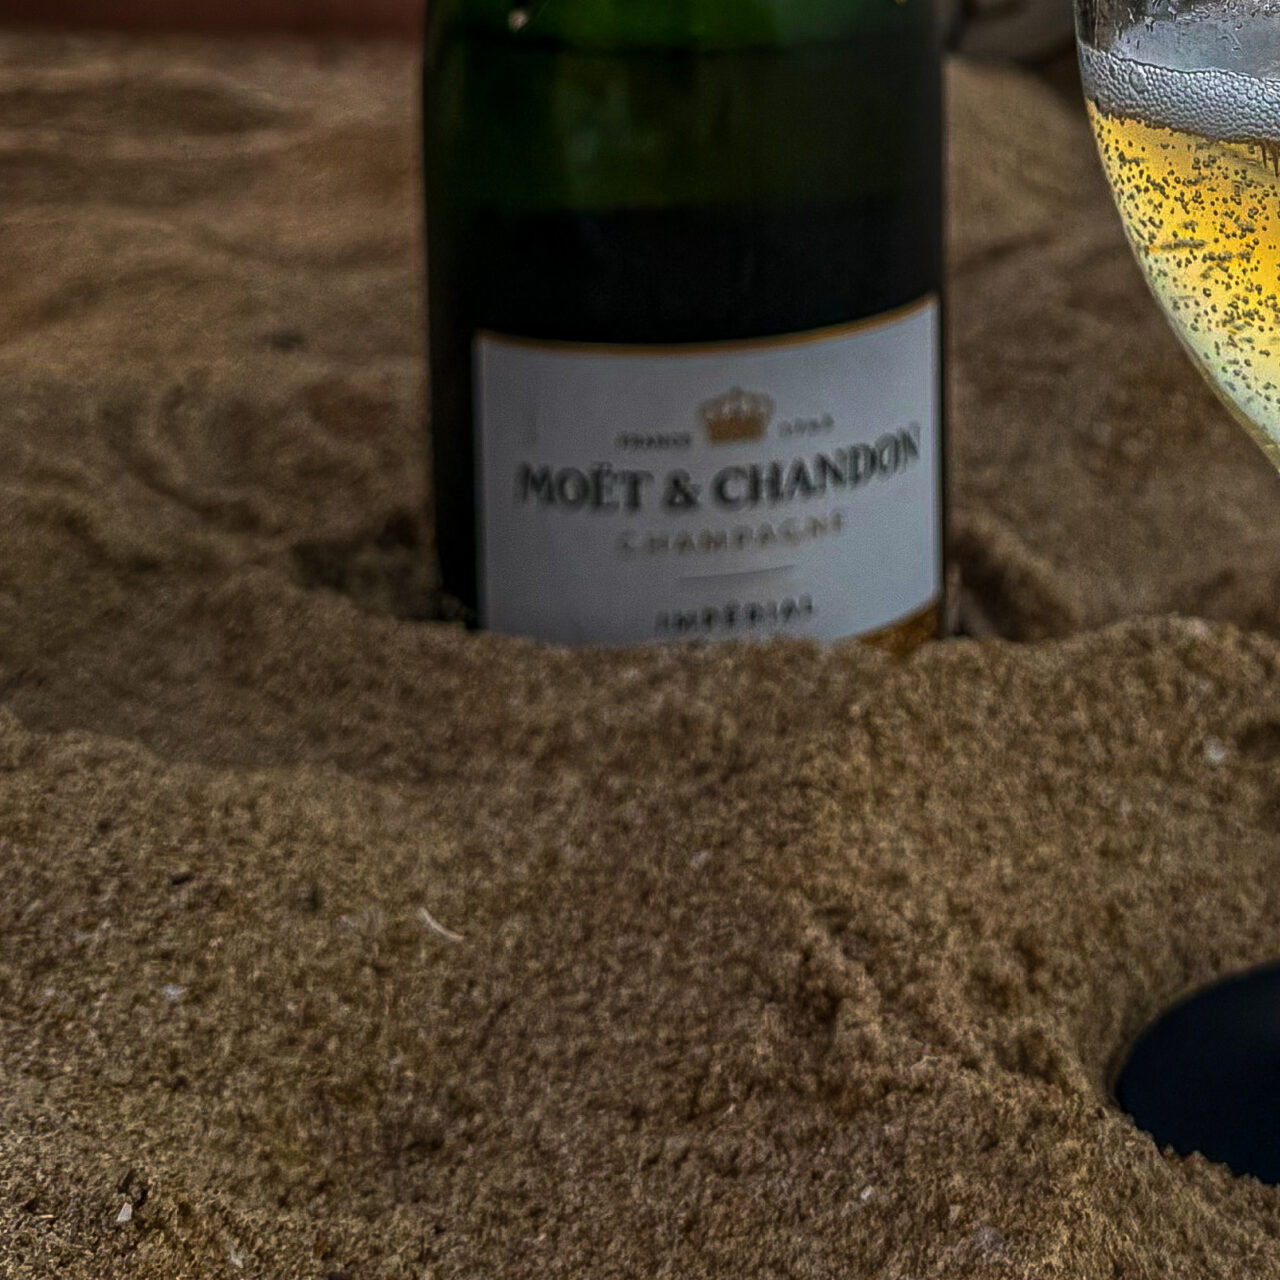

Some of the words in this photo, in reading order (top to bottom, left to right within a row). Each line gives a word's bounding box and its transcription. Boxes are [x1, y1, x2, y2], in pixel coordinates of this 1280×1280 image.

[517, 461, 655, 513] MOËT
[662, 468, 701, 513] &
[711, 424, 920, 511] CHANDON
